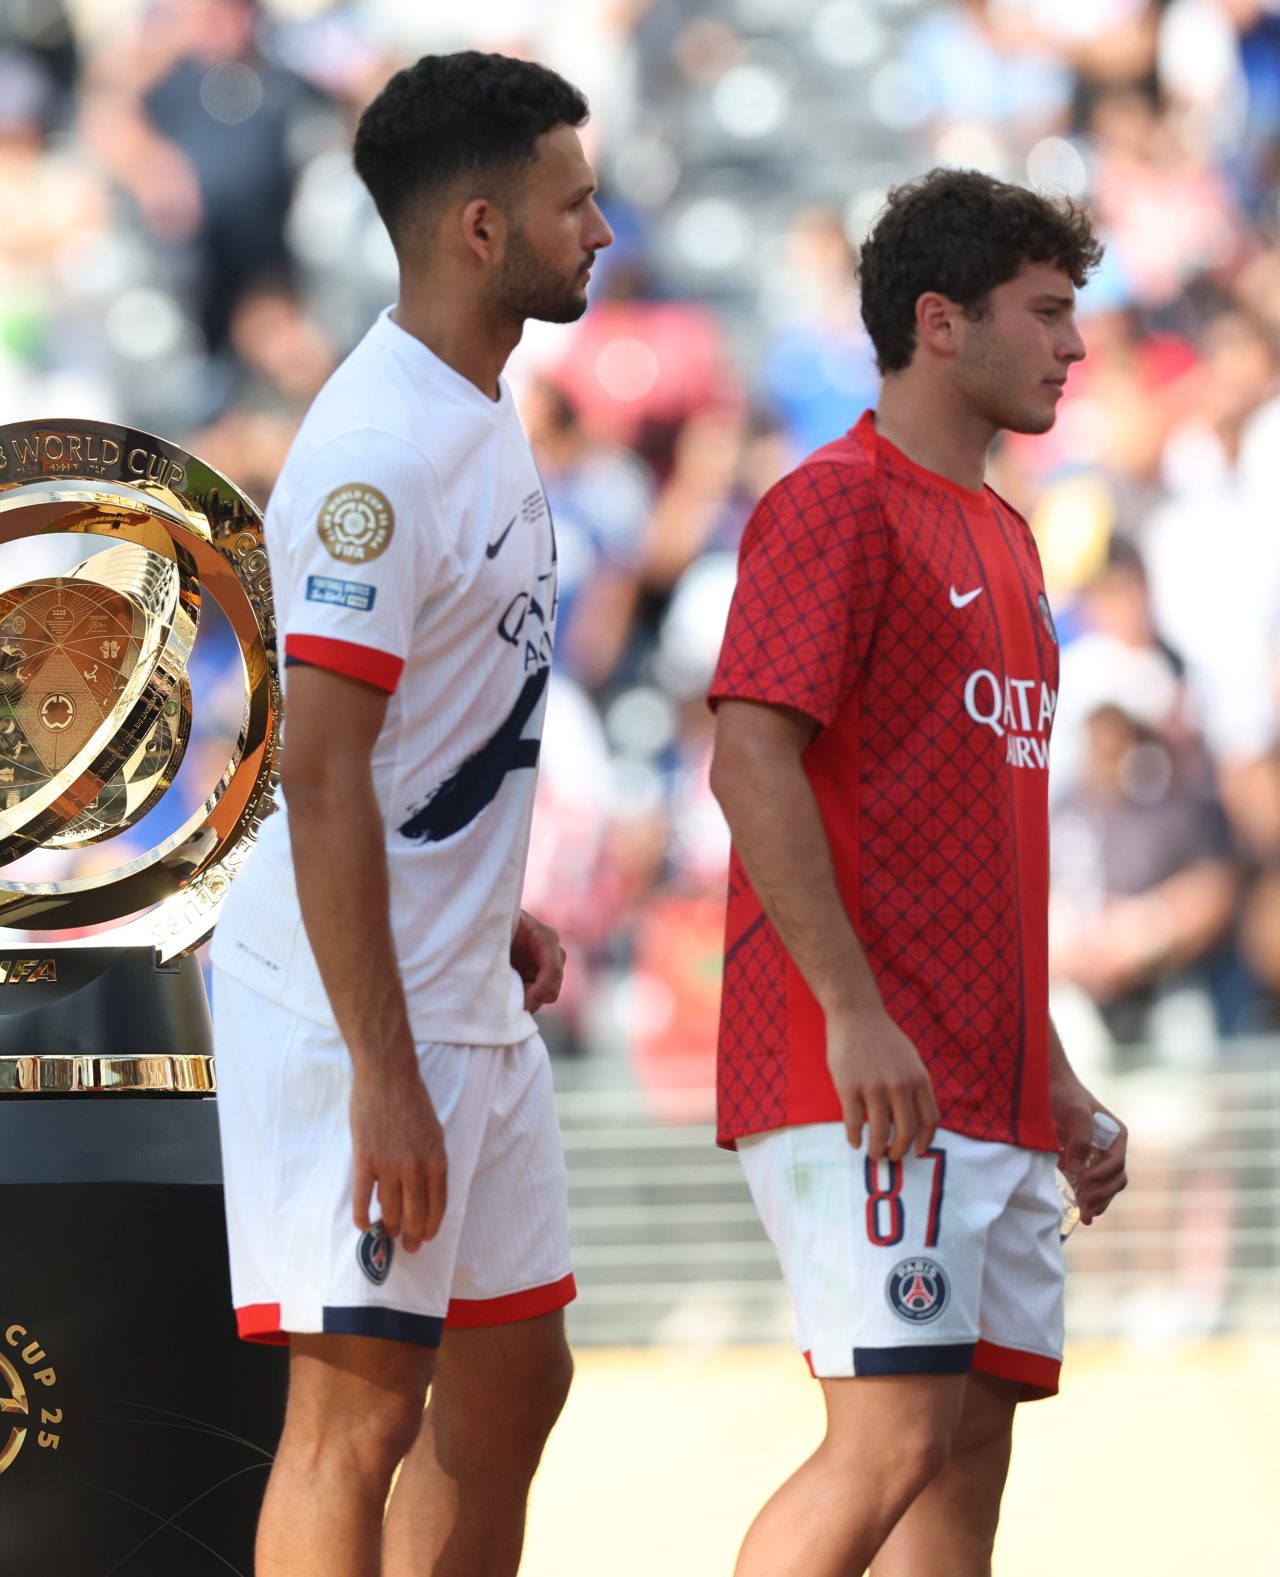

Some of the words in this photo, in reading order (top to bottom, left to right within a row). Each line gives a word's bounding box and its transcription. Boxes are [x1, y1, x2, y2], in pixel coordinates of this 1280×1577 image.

[11, 435, 120, 466] WORLD
[127, 448, 187, 488] CUP
[964, 669, 1057, 737] QATA
[864, 1147, 946, 1248] 87
[896, 1261, 939, 1279] PARIS
[5, 1324, 57, 1387] CUP
[37, 1408, 63, 1450] 25
